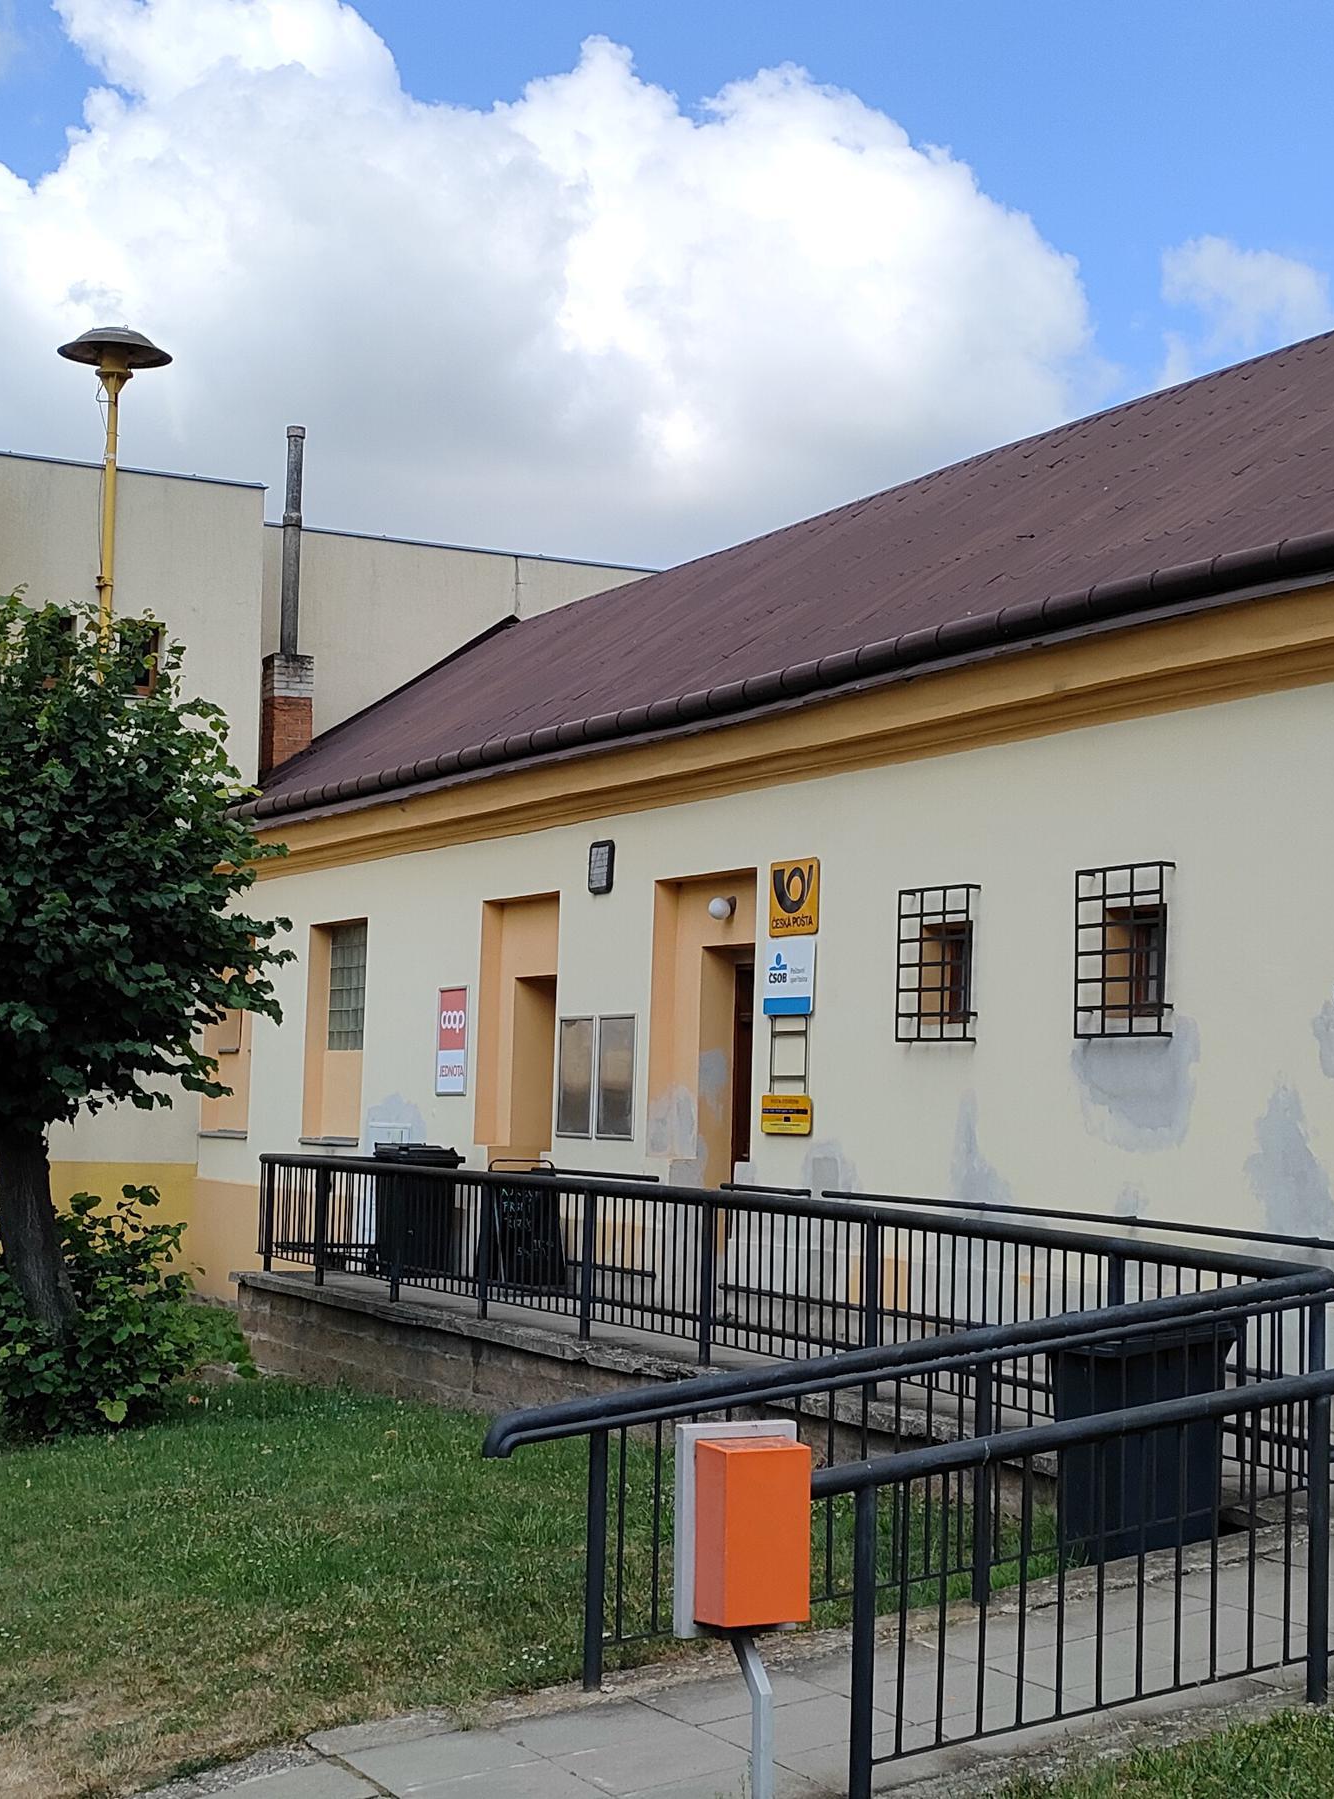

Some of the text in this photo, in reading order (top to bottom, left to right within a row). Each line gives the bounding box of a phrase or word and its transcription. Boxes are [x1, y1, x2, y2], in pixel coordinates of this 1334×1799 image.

[771, 913, 814, 929] ČESKÁ POŠTA
[768, 971, 788, 984] ČSOB
[441, 1010, 465, 1034] coop
[439, 1065, 465, 1078] JEDNOTA
